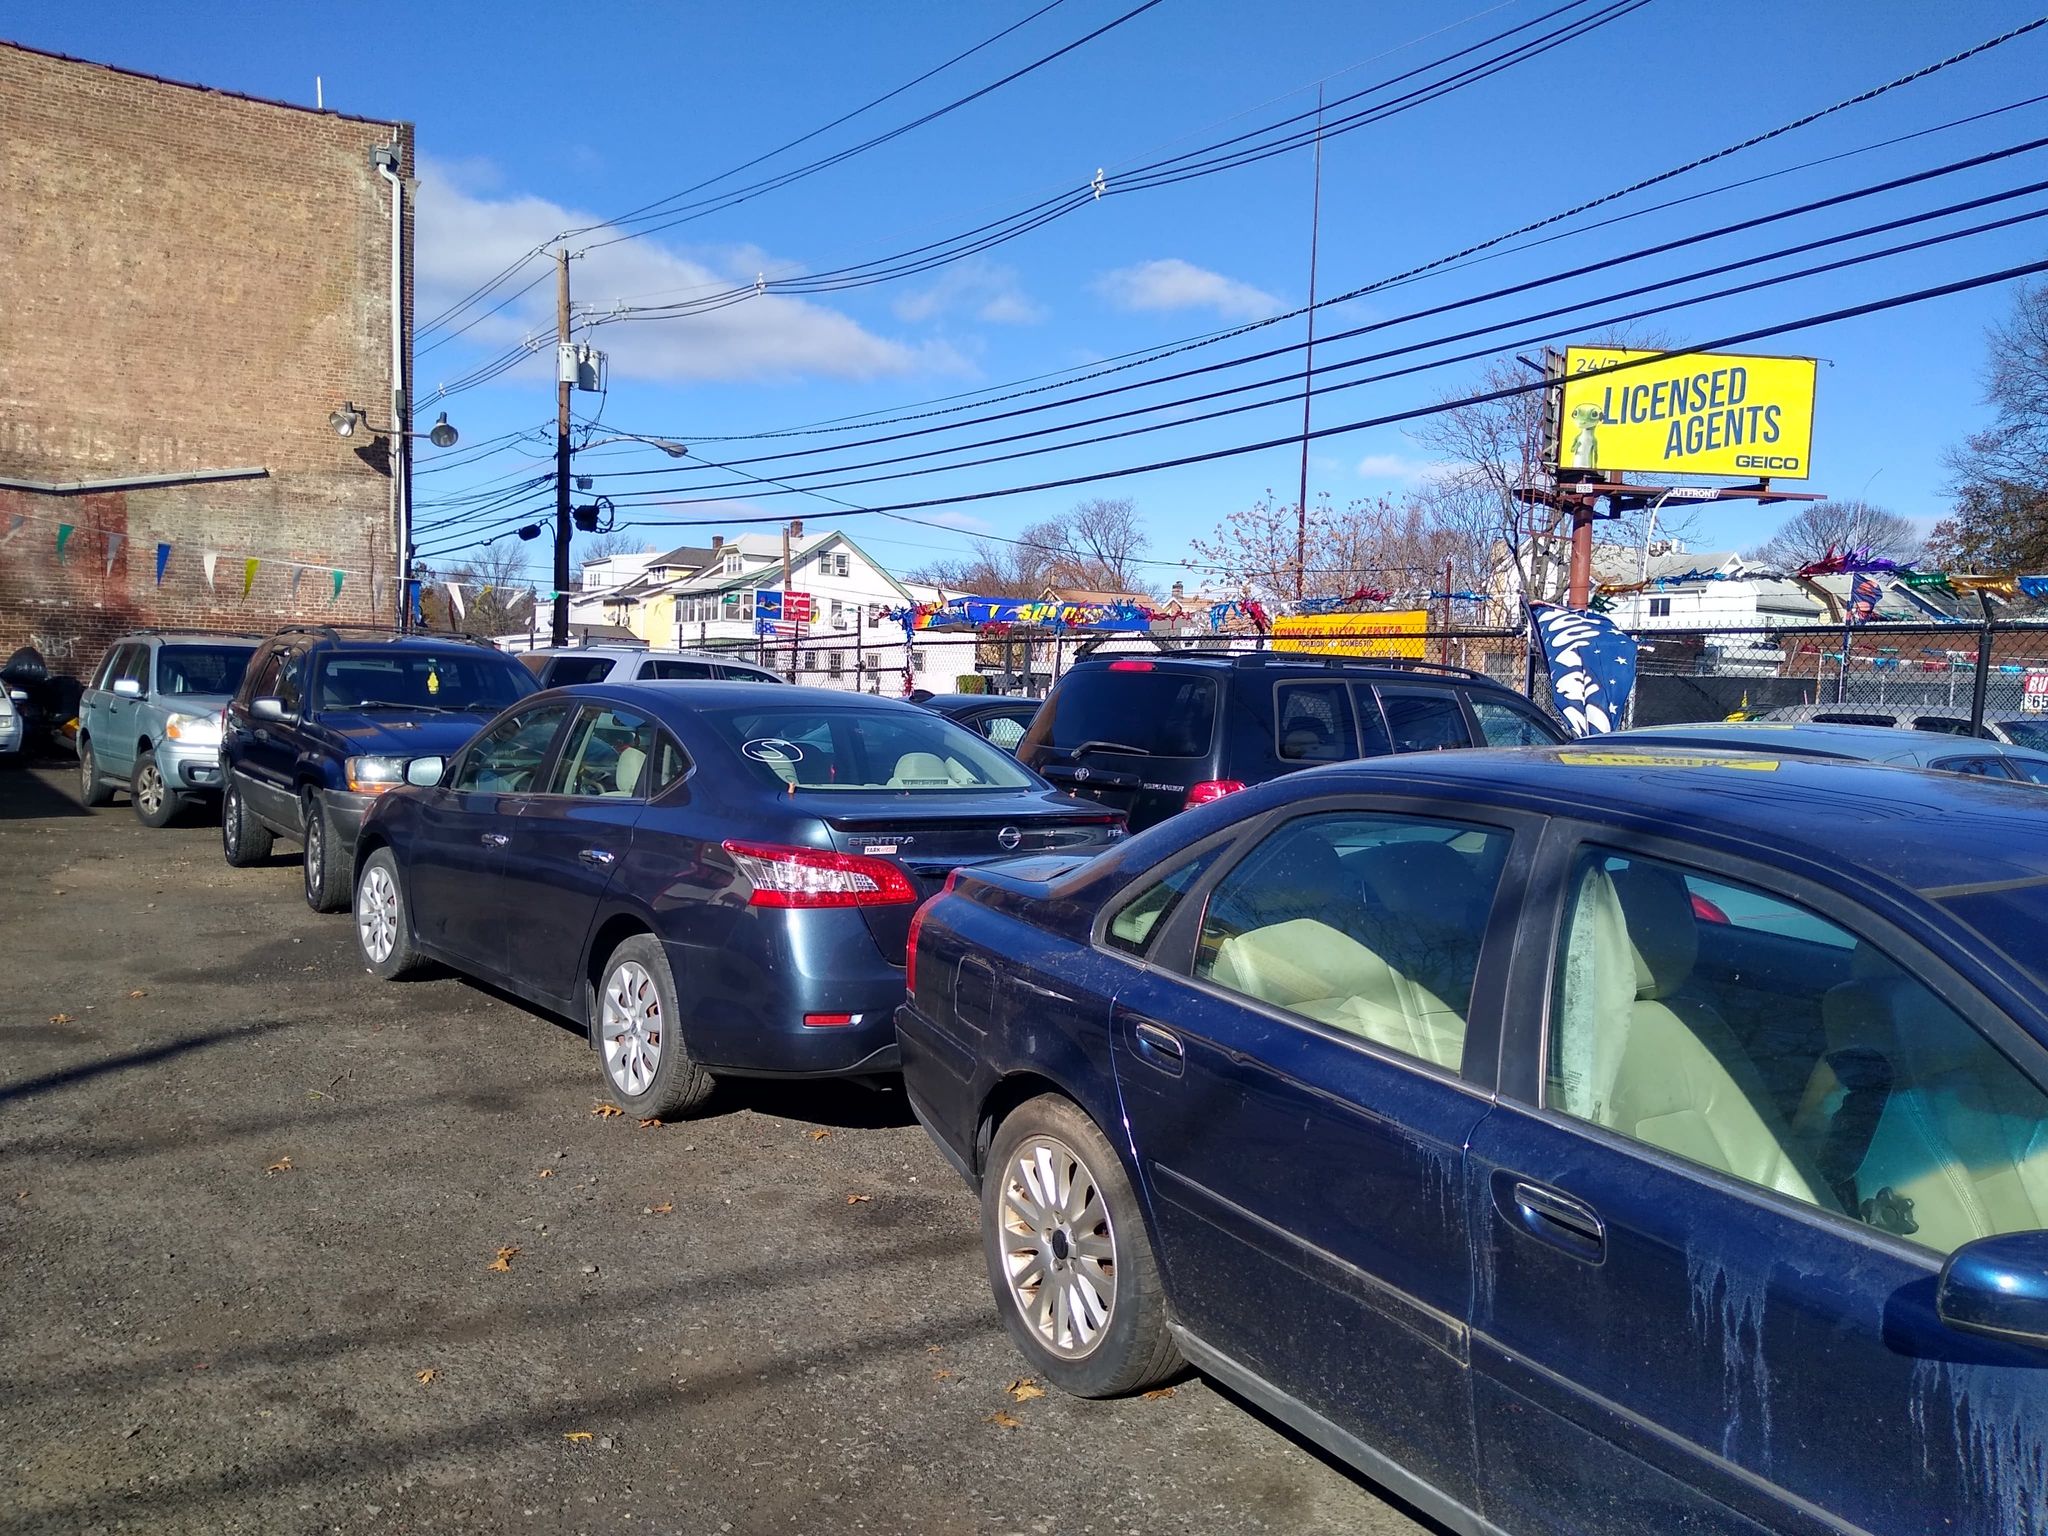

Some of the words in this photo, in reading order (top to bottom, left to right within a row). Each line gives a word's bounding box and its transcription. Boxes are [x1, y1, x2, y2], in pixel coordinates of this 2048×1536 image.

[1602, 367, 1747, 425] LICENSED
[1663, 405, 1782, 460] AGENTS
[1735, 454, 1799, 470] GEICO
[847, 836, 915, 846] SENTRA
